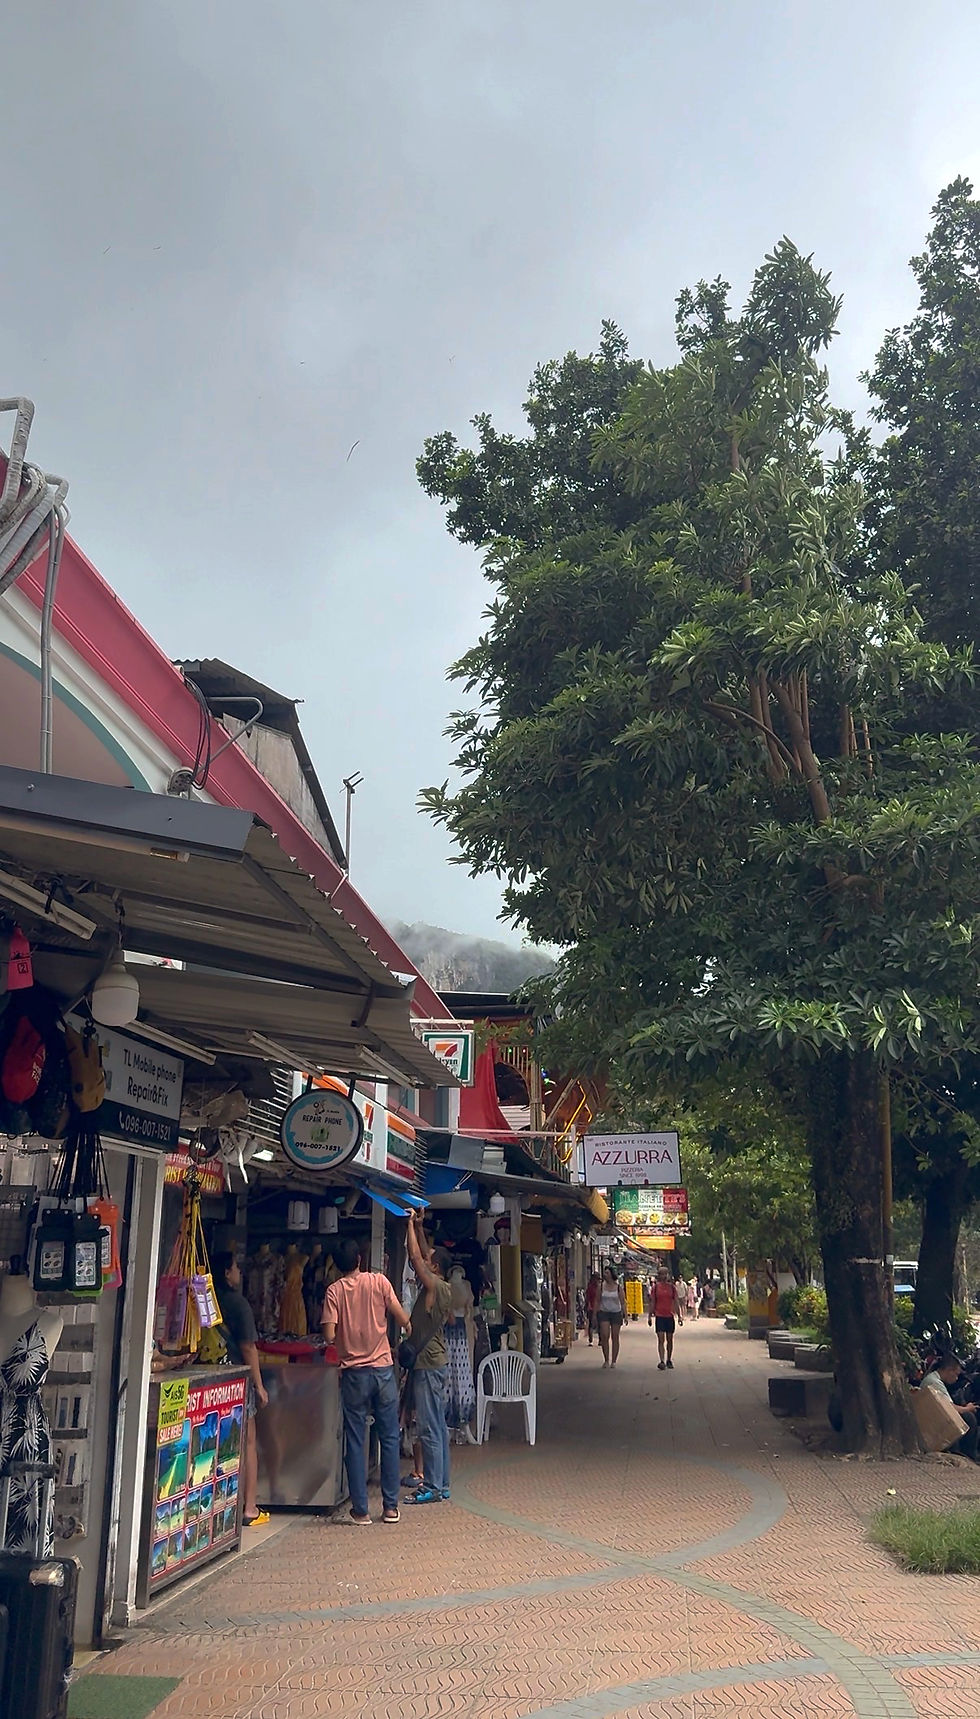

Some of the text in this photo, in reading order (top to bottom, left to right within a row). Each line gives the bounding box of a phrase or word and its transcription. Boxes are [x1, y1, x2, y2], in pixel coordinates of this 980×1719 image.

[123, 1049, 177, 1083] TL Mobile phone
[127, 1076, 168, 1107] Repair&Fix
[125, 1115, 171, 1140] 096-007-1521
[302, 1114, 343, 1125] REPAIR PHONE
[295, 1141, 341, 1152] 096-007-1521
[592, 1149, 673, 1166] AZZURRA
[202, 1382, 245, 1409] INFORMATION
[161, 1409, 179, 1425] TOURIST
[160, 1426, 171, 1442] SALE
